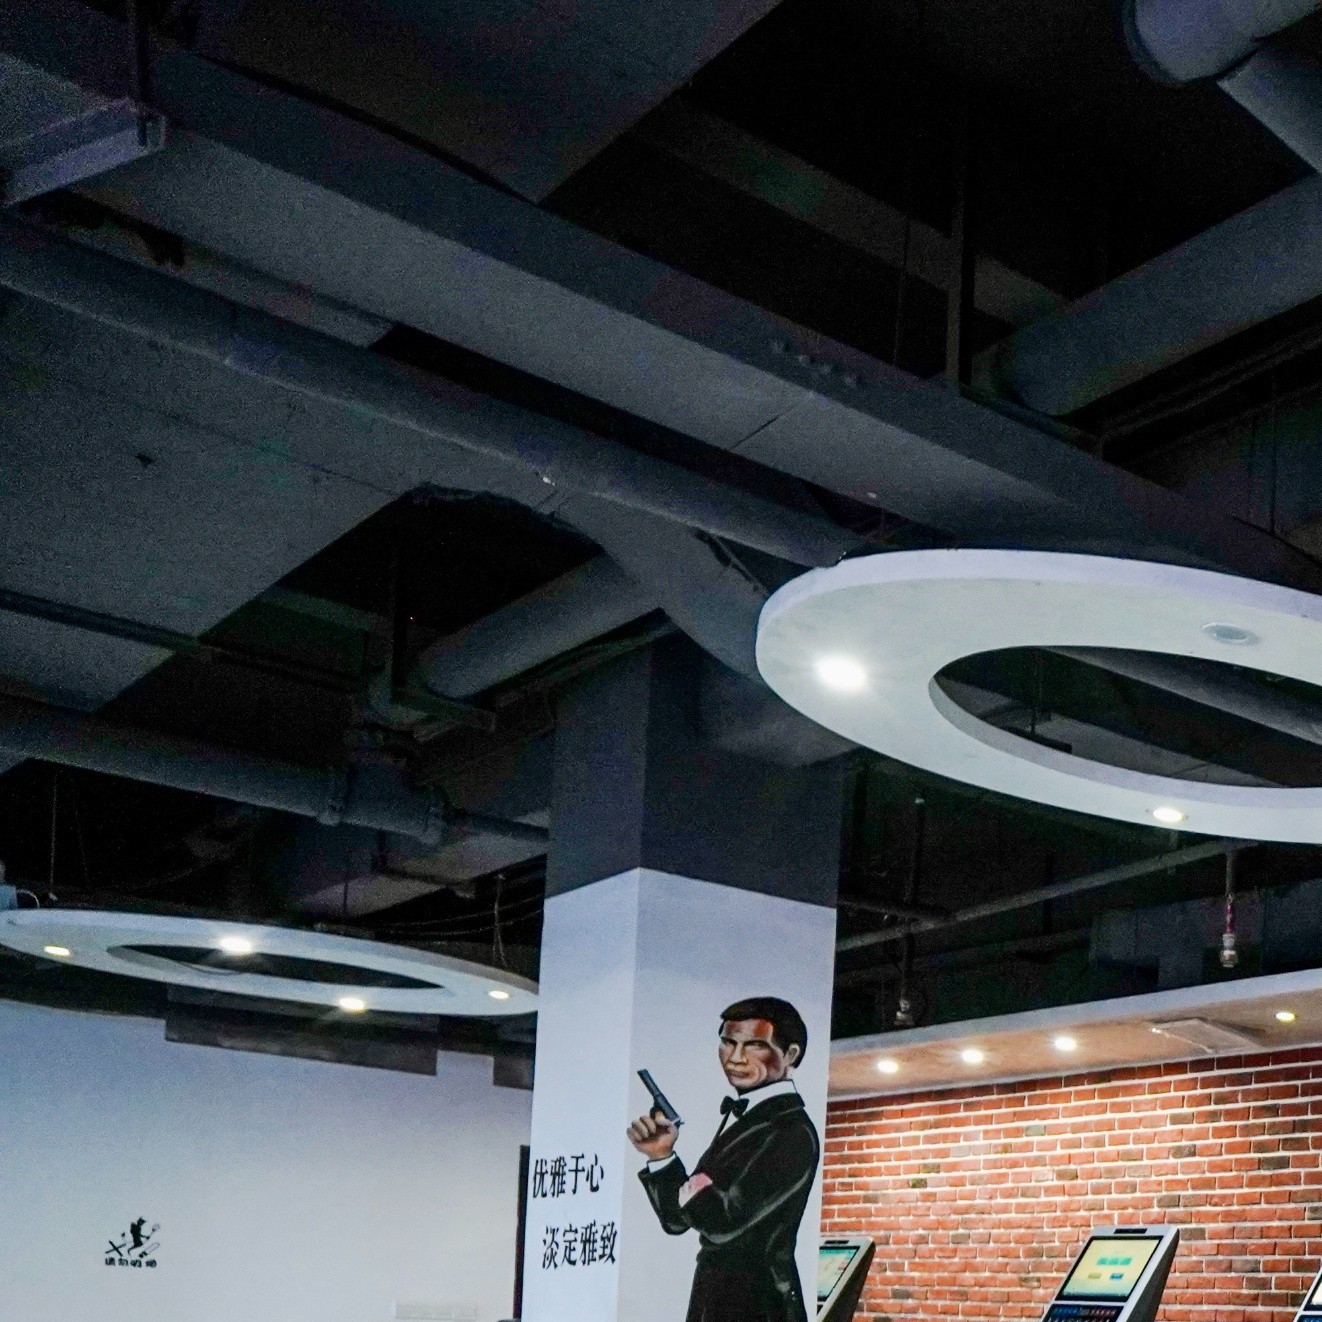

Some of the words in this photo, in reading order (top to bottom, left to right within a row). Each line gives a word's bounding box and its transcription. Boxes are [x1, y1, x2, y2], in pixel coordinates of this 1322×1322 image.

[532, 1153, 605, 1199] 优雅于心
[542, 1220, 618, 1270] 淡定雅致
